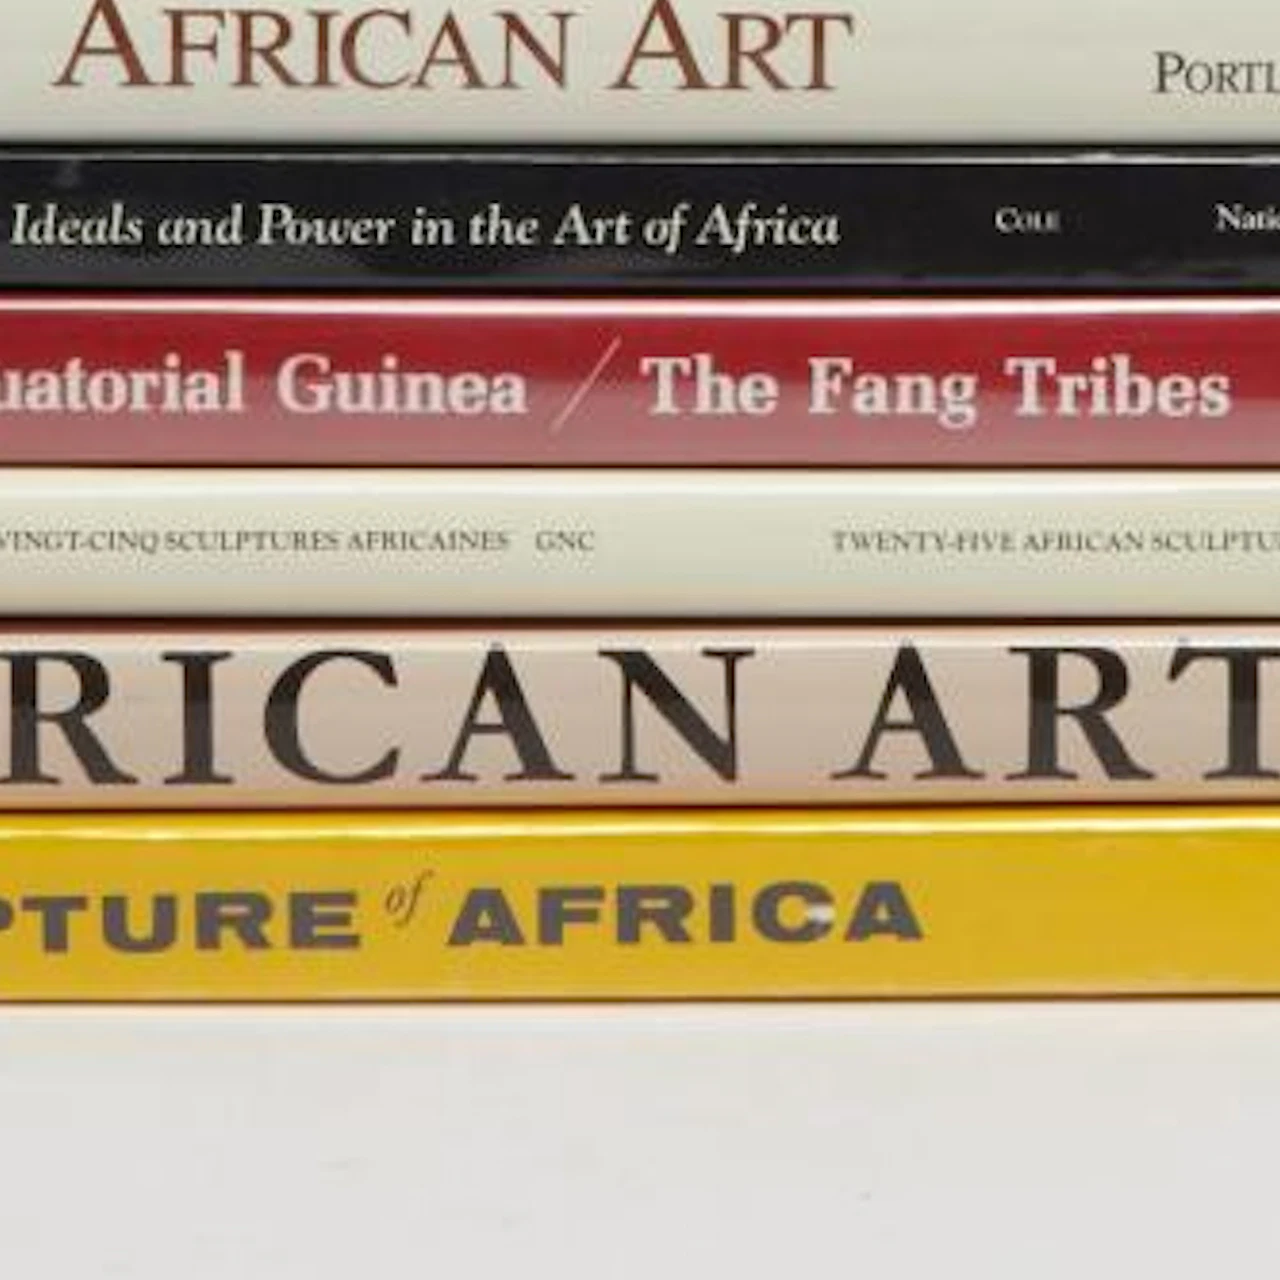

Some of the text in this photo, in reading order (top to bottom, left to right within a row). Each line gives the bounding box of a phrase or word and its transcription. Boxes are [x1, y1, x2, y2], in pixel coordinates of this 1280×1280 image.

[9, 201, 841, 254] Ideals and Power in the Art of Africa
[275, 353, 530, 416] Guinea
[640, 354, 779, 416] The
[806, 355, 980, 429] Fang
[1004, 353, 1233, 419] Tribes
[165, 528, 339, 553] SCULPTURES
[346, 528, 511, 553] AFRICAINES
[534, 528, 596, 553] GNC
[832, 529, 1017, 554] TWENTY-FIVE
[1022, 529, 1147, 554] AFRICAN
[384, 866, 431, 929] of
[444, 879, 925, 948] AFRICA
